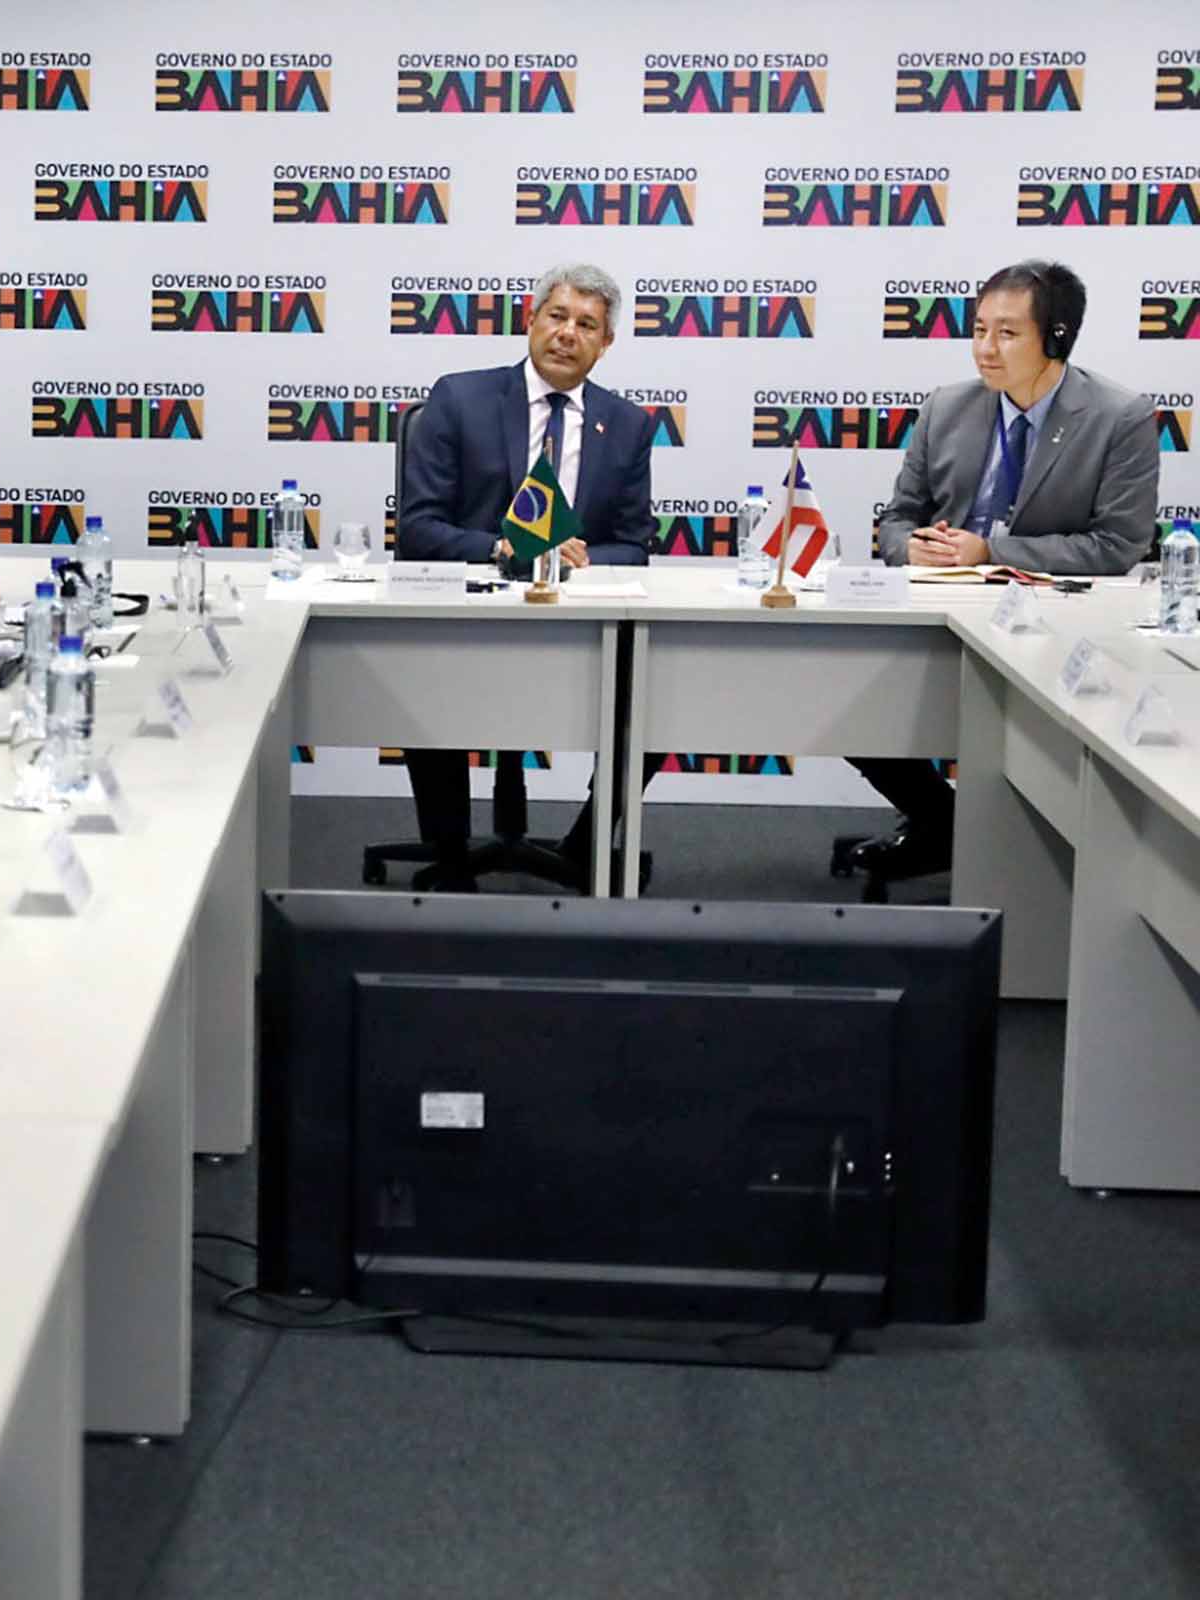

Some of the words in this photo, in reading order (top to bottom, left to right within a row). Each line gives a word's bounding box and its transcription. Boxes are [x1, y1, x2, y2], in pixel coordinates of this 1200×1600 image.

[2, 52, 25, 66] DO
[30, 53, 91, 66] ESTADO
[156, 53, 236, 67] GOVERNO
[242, 54, 264, 67] DO
[270, 54, 332, 67] ESTADO
[398, 54, 480, 68] GOVERNO
[486, 54, 509, 68] DO
[515, 54, 577, 68] ESTADO
[645, 54, 728, 68] GOVERNO
[734, 54, 758, 68] DO
[764, 53, 828, 68] ESTADO
[898, 53, 983, 67] GOVERNO
[989, 52, 1014, 66] DO
[1020, 52, 1086, 66] ESTADO
[155, 70, 329, 112] BAHIA
[397, 71, 574, 113] BAHIA
[644, 71, 824, 113] BAHIA
[896, 69, 1082, 112] BAHIA
[35, 163, 115, 178] GOVERNO
[120, 164, 142, 178] DO
[148, 164, 209, 178] ESTADO
[274, 165, 355, 179] GOVERNO
[360, 166, 383, 179] DO
[389, 166, 450, 180] ESTADO
[517, 167, 599, 181] GOVERNO
[605, 167, 628, 181] DO
[634, 167, 697, 181] ESTADO
[765, 168, 849, 181] GOVERNO
[855, 168, 878, 181] DO
[884, 168, 949, 181] ESTADO
[1020, 167, 1106, 181] GOVERNO
[1112, 167, 1136, 180] DO
[1143, 166, 1200, 180] ESTAD
[35, 181, 206, 221] BAHIA
[273, 183, 448, 223] BAHIA
[516, 184, 693, 225] BAHIA
[763, 185, 946, 226] BAHIA
[1017, 184, 1200, 226] BAHIA
[0, 272, 22, 286] DO
[27, 273, 88, 287] ESTADO
[152, 274, 232, 288] GOVERNO
[237, 275, 260, 288] DO
[265, 275, 326, 289] ESTADO
[392, 276, 472, 290] GOVERNO
[478, 278, 501, 291] DO
[636, 279, 718, 293] GOVERNO
[724, 280, 747, 293] DO
[753, 280, 817, 294] ESTADO
[885, 280, 970, 294] GOVERNO
[151, 291, 324, 333] BAHIA
[634, 296, 814, 338] BAHIA
[32, 381, 111, 395] GOVERNO
[116, 382, 138, 396] DO
[144, 383, 204, 397] ESTADO
[269, 384, 348, 399] GOVERNO
[354, 386, 377, 399] DO
[382, 386, 431, 400] ESTAD
[754, 390, 837, 405] GOVERNO
[843, 391, 867, 405] DO
[32, 398, 203, 438] BAHIA
[25, 488, 85, 503] ESTADO
[148, 490, 228, 505] GOVERNO
[232, 492, 255, 506] DO
[714, 501, 737, 514] DO
